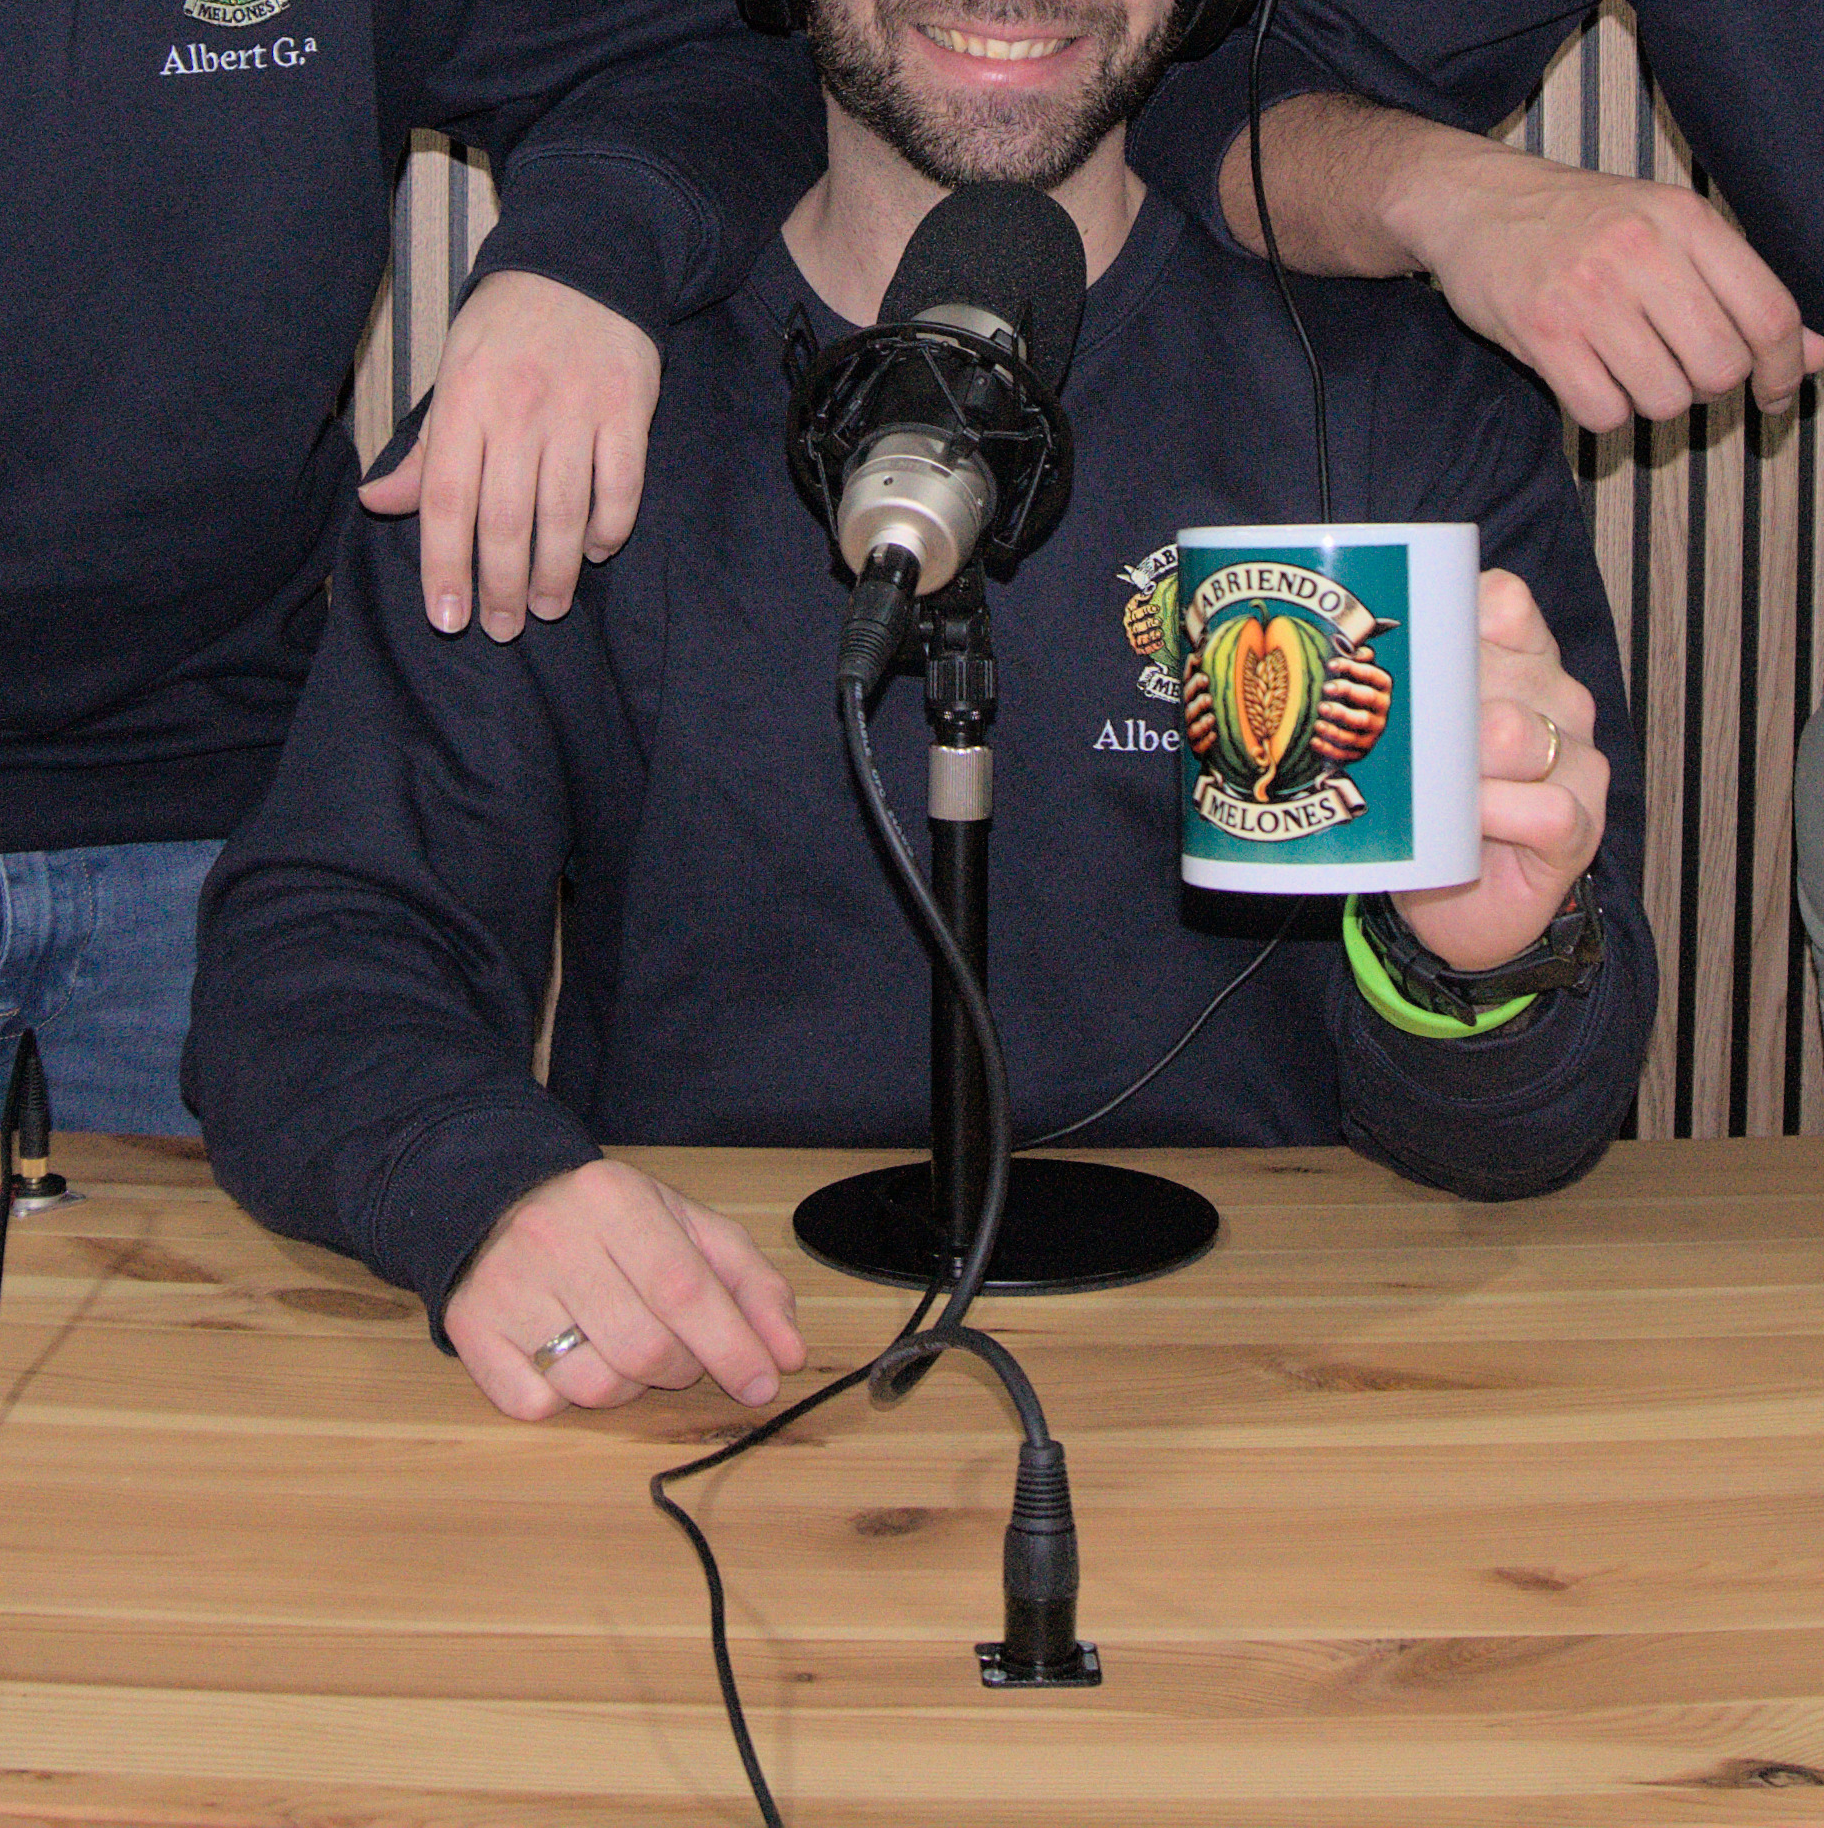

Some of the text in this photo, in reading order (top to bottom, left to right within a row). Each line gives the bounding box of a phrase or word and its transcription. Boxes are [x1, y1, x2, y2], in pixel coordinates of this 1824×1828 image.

[198, 0, 276, 23] MELONES
[160, 43, 268, 76] Albert
[1198, 569, 1343, 612] ABRIENDO
[1093, 719, 1180, 752] Albe
[1208, 797, 1337, 834] MELONES
